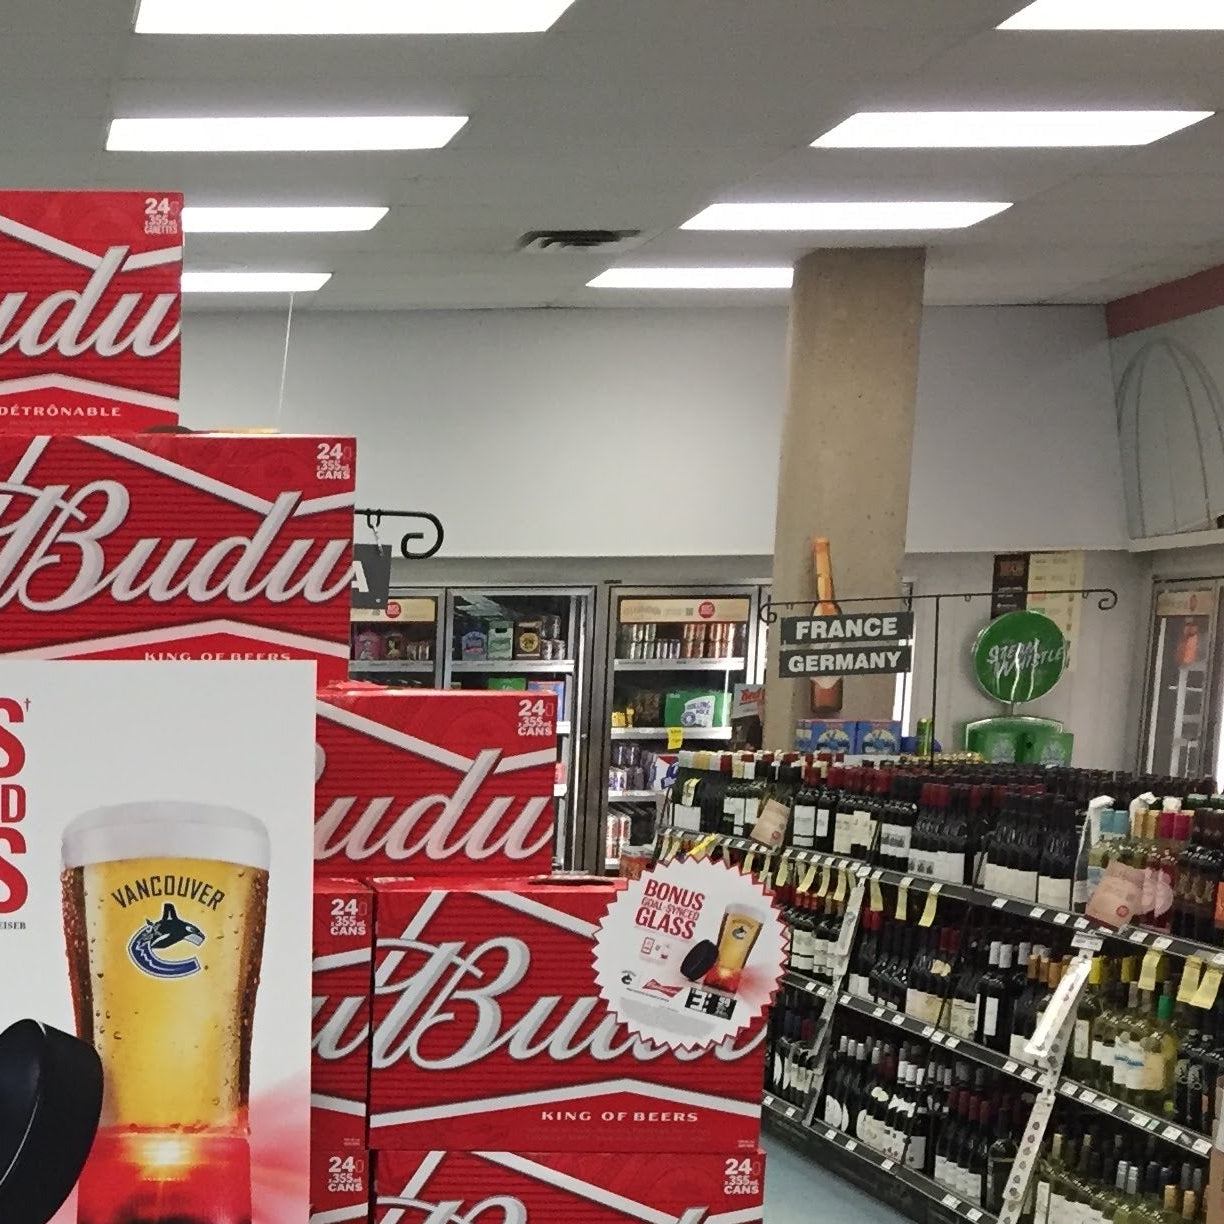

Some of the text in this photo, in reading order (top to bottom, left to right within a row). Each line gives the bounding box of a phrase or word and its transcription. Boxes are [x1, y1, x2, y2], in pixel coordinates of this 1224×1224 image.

[145, 198, 170, 213] 24
[317, 444, 343, 459] 24
[317, 471, 350, 479] CANS
[796, 617, 898, 640] FRANCE
[788, 651, 901, 673] GERMANY
[518, 700, 545, 716] 24
[517, 727, 552, 736] CANS
[111, 875, 225, 911] VANCOUVER
[644, 878, 706, 911] BONUS
[331, 899, 357, 915] 24
[635, 906, 696, 940] GLASS
[331, 926, 366, 936] CANS
[542, 1111, 698, 1121] KING OF BEERS
[328, 1157, 354, 1173] 24
[725, 1159, 752, 1174] 24
[328, 1183, 362, 1191] CANS
[724, 1185, 759, 1194] CANS
